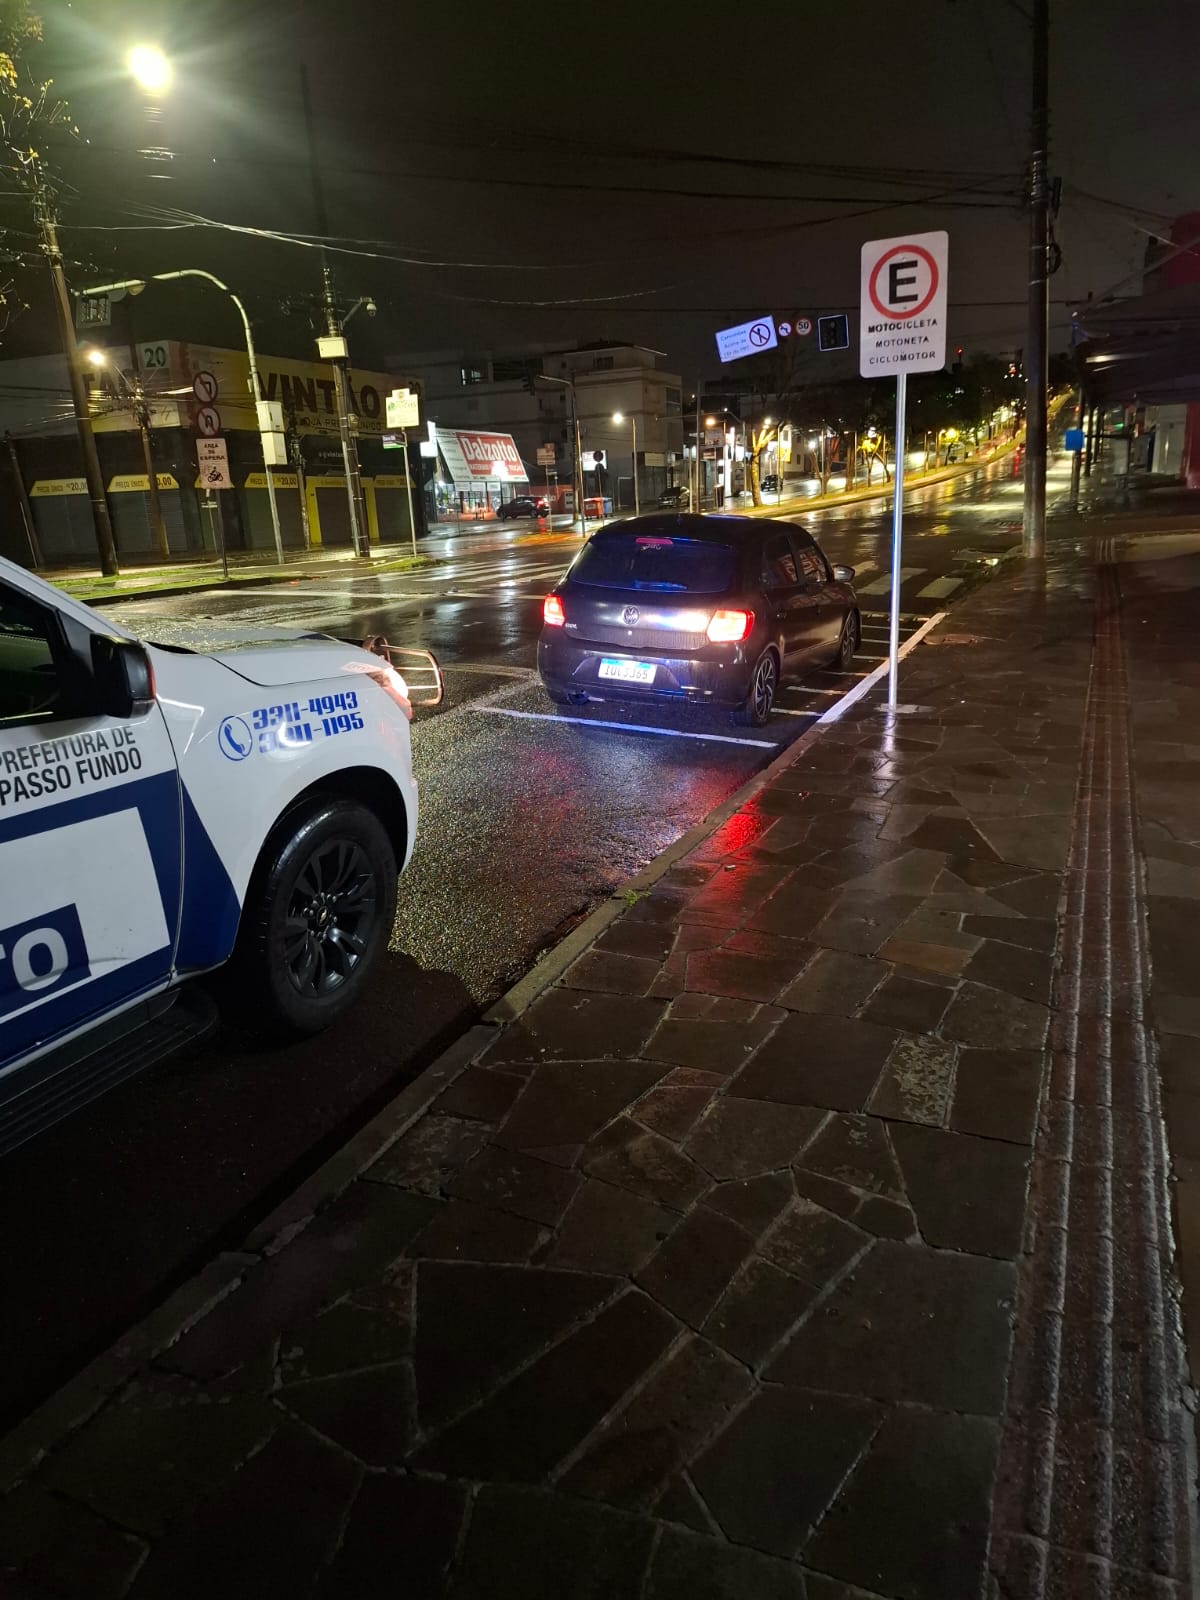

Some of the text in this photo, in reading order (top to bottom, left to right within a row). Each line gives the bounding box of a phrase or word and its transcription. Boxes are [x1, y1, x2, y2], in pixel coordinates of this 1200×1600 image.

[888, 259, 919, 305] E
[798, 321, 809, 330] 50
[868, 318, 938, 333] MOTOCICLETA
[875, 336, 930, 348] MOTONETA
[143, 346, 166, 368] 20
[868, 351, 936, 365] CICLOMOTOR
[460, 437, 518, 464] Dalzotto
[252, 691, 359, 730] 3311-4943
[0, 725, 136, 774] REFEITURA DE
[0, 747, 142, 806] PASSO FUNDO
